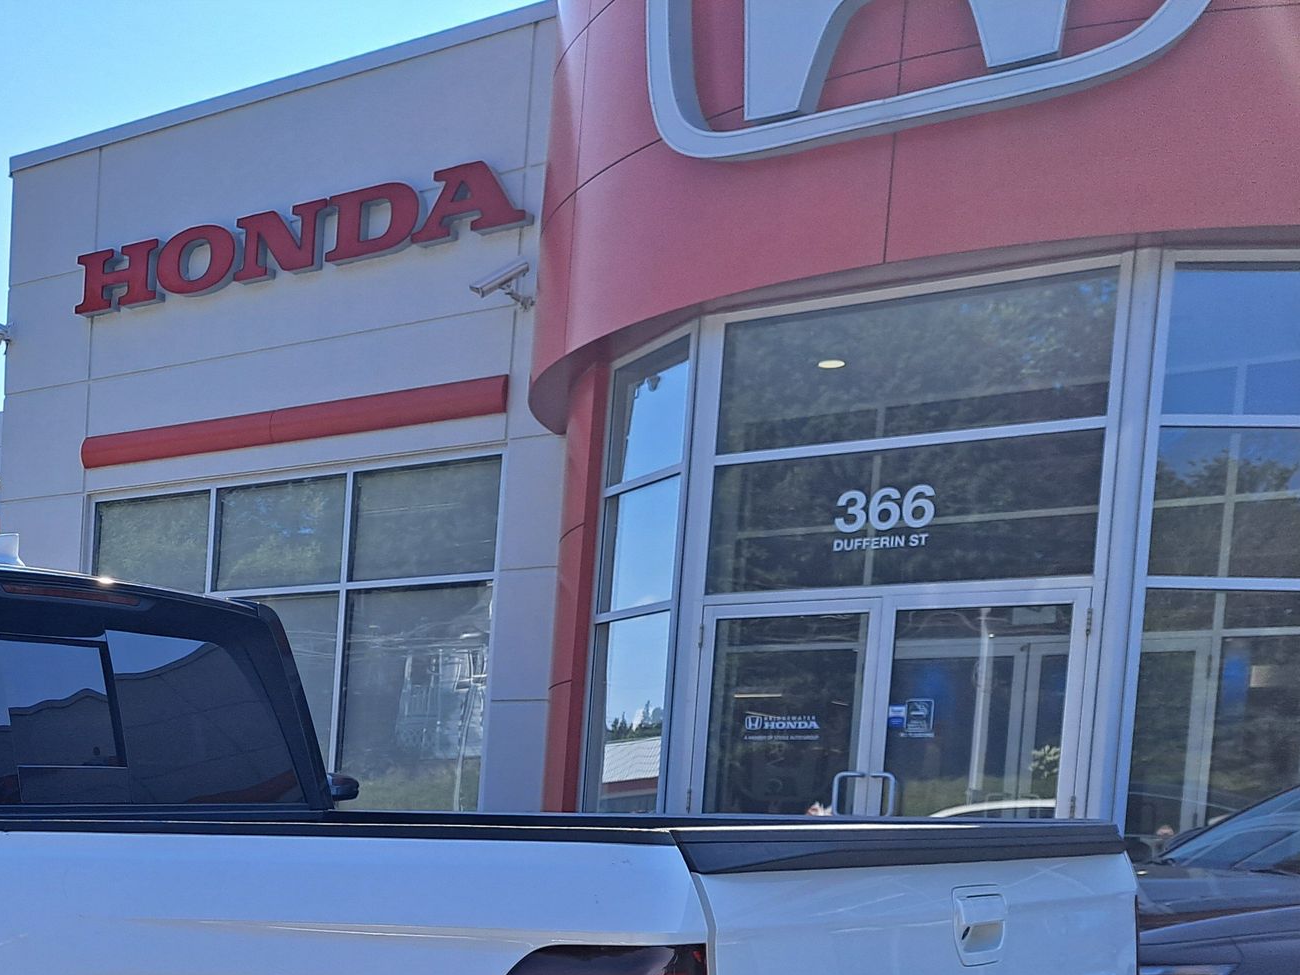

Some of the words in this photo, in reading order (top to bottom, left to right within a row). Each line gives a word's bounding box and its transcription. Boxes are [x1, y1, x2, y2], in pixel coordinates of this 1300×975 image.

[75, 160, 530, 316] HONDA
[834, 484, 936, 533] 366
[832, 535, 906, 552] DUFFERIN
[909, 533, 929, 547] ST
[763, 721, 820, 730] HONDA
